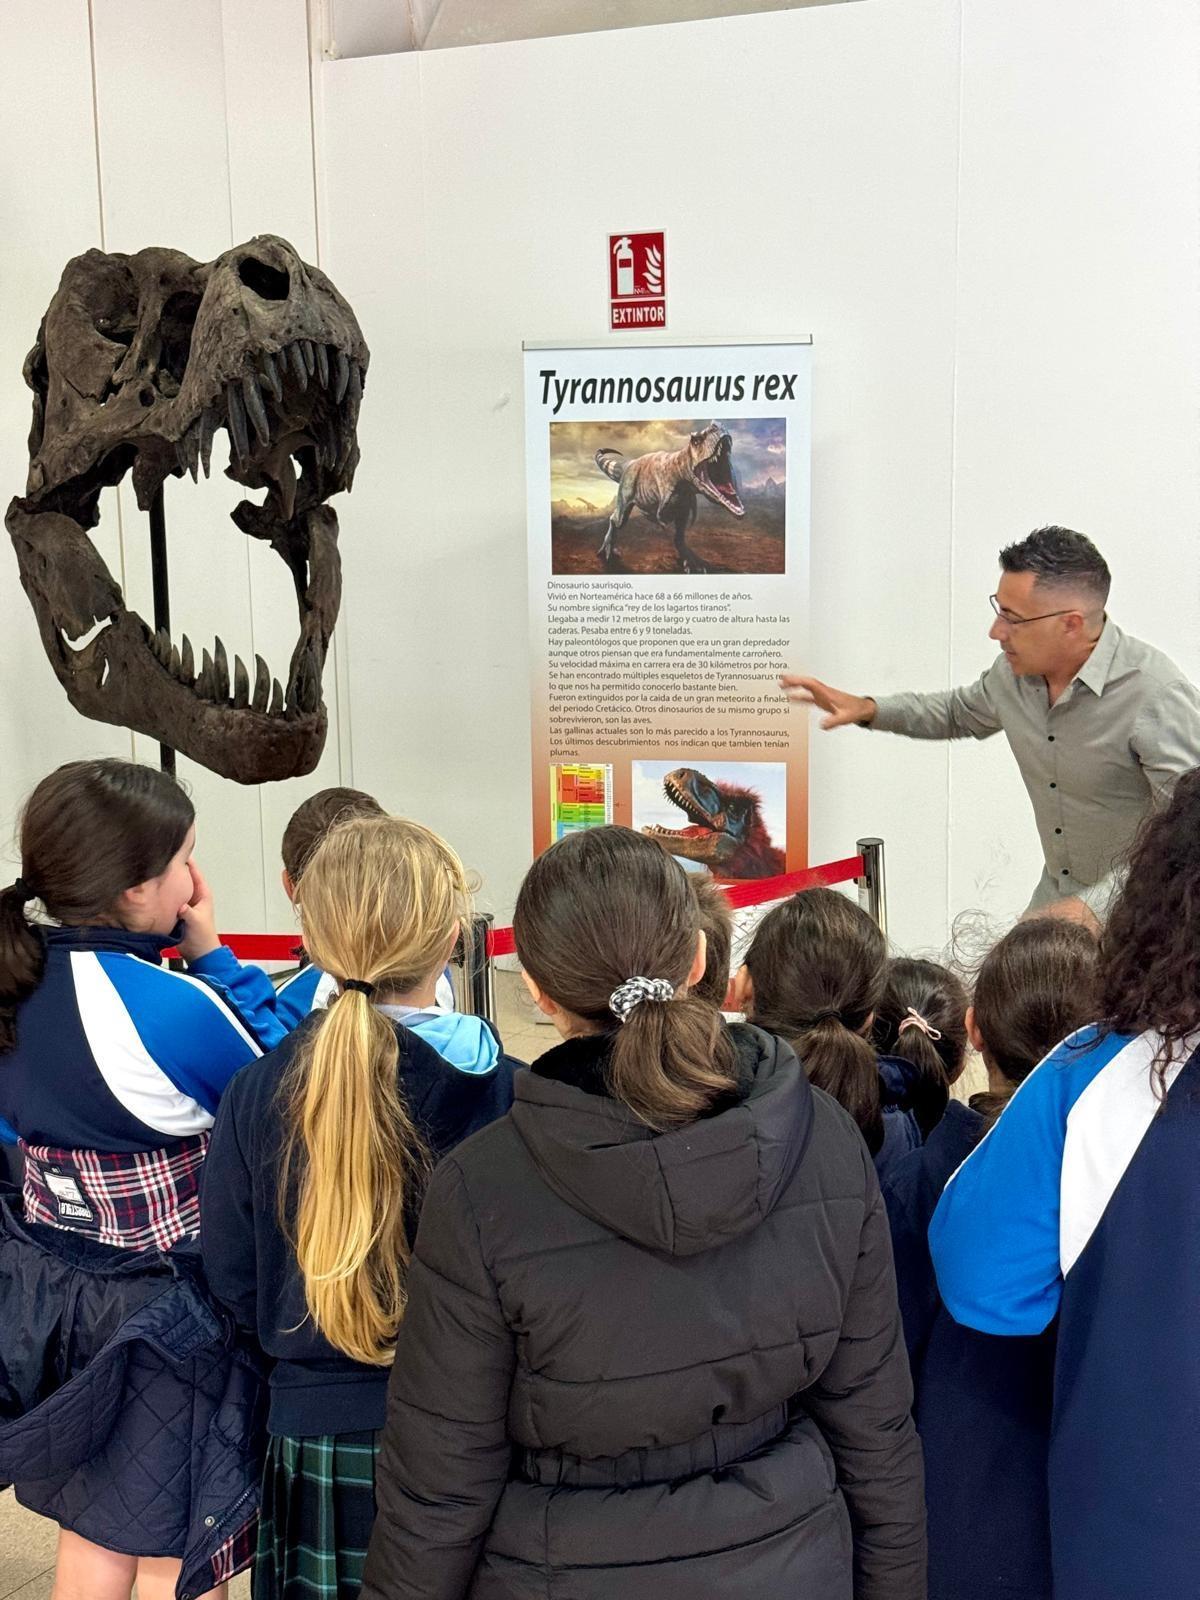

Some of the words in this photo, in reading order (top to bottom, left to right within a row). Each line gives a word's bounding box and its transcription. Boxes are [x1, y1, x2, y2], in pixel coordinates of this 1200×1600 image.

[613, 306, 664, 323] EXTINTOR
[539, 370, 745, 415] Tyrannosaurus
[752, 373, 798, 401] rex
[547, 581, 590, 589] Dinosaurio
[591, 581, 634, 591] saurisquio.
[547, 592, 567, 600] Vivió
[580, 592, 633, 600] Norteamérica
[635, 592, 654, 600] hace
[655, 592, 665, 600] 68
[673, 592, 683, 600] 66
[685, 592, 718, 600] millones
[720, 592, 730, 600] de
[732, 592, 752, 600] años.
[547, 603, 557, 612] Su
[559, 603, 590, 612] nombre
[592, 603, 624, 613] significa
[641, 603, 652, 611] de
[654, 603, 665, 611] los
[666, 603, 698, 613] lagartos
[548, 614, 578, 625] Llegaba
[586, 614, 610, 623] medir
[612, 614, 621, 623] 12
[651, 614, 662, 623] de
[664, 615, 684, 625] largo
[685, 617, 690, 625] y
[719, 615, 730, 623] de
[731, 615, 754, 623] altura
[756, 615, 777, 623] hasta
[779, 615, 790, 623] las
[548, 626, 580, 634] caderas.
[581, 626, 608, 634] Pesaba
[632, 626, 638, 634] 6
[639, 628, 644, 636] y
[646, 626, 651, 634] 9
[652, 626, 692, 634] toneladas.
[549, 638, 564, 648] Hay
[564, 638, 621, 648] paleontólogos
[622, 640, 638, 648] que
[639, 640, 678, 648] proponen
[680, 640, 695, 648] que
[722, 640, 741, 648] gran
[742, 638, 790, 648] depredador
[548, 650, 578, 659] aunque
[601, 649, 632, 659] piensan
[634, 651, 649, 659] que
[664, 649, 740, 657] fundamentalmente
[742, 649, 784, 657] carroñero.
[548, 660, 559, 668] Su
[560, 660, 598, 668] velocidad
[599, 660, 630, 668] máxima
[686, 660, 696, 668] de
[698, 660, 708, 668] 30
[710, 660, 752, 668] kilómetros
[753, 662, 768, 670] por
[769, 660, 789, 669] hora.
[548, 671, 558, 679] Se
[560, 671, 575, 679] han
[576, 671, 622, 679] encontrado
[623, 671, 659, 681] múltiples
[660, 671, 704, 681] esqueletos
[704, 671, 716, 680] de
[715, 672, 774, 682] Tyrannosuarus
[549, 682, 556, 690] lo
[558, 684, 573, 692] que
[590, 682, 600, 690] ha
[602, 682, 641, 692] permitido
[641, 682, 681, 691] conocerlo
[682, 683, 716, 691] bastante
[718, 683, 738, 691] bien.
[549, 693, 576, 702] Fueron
[578, 694, 624, 704] extinguidos
[624, 696, 640, 704] por
[640, 694, 648, 702] la
[671, 694, 682, 702] de
[696, 696, 714, 704] gran
[716, 694, 756, 702] meteorito
[764, 694, 792, 702] finales
[549, 704, 562, 712] del
[595, 705, 634, 713] Cretácico.
[634, 705, 656, 713] Otros
[658, 705, 703, 713] dinosaurios
[705, 705, 715, 713] de
[728, 705, 756, 714] mismo
[756, 708, 782, 716] grupo
[549, 715, 604, 724] sobrevivieron,
[620, 716, 632, 724] las
[550, 726, 562, 734] Las
[564, 726, 594, 736] gallinas
[596, 726, 628, 734] actuales
[645, 727, 654, 735] lo
[656, 727, 673, 735] más
[672, 727, 709, 737] parecido
[717, 727, 728, 735] los
[730, 728, 790, 738] Tyrannosaurus,
[550, 737, 564, 745] Los
[564, 737, 595, 745] últimos
[594, 738, 660, 746] descubrimientos
[680, 738, 709, 746] indican
[712, 740, 727, 749] que
